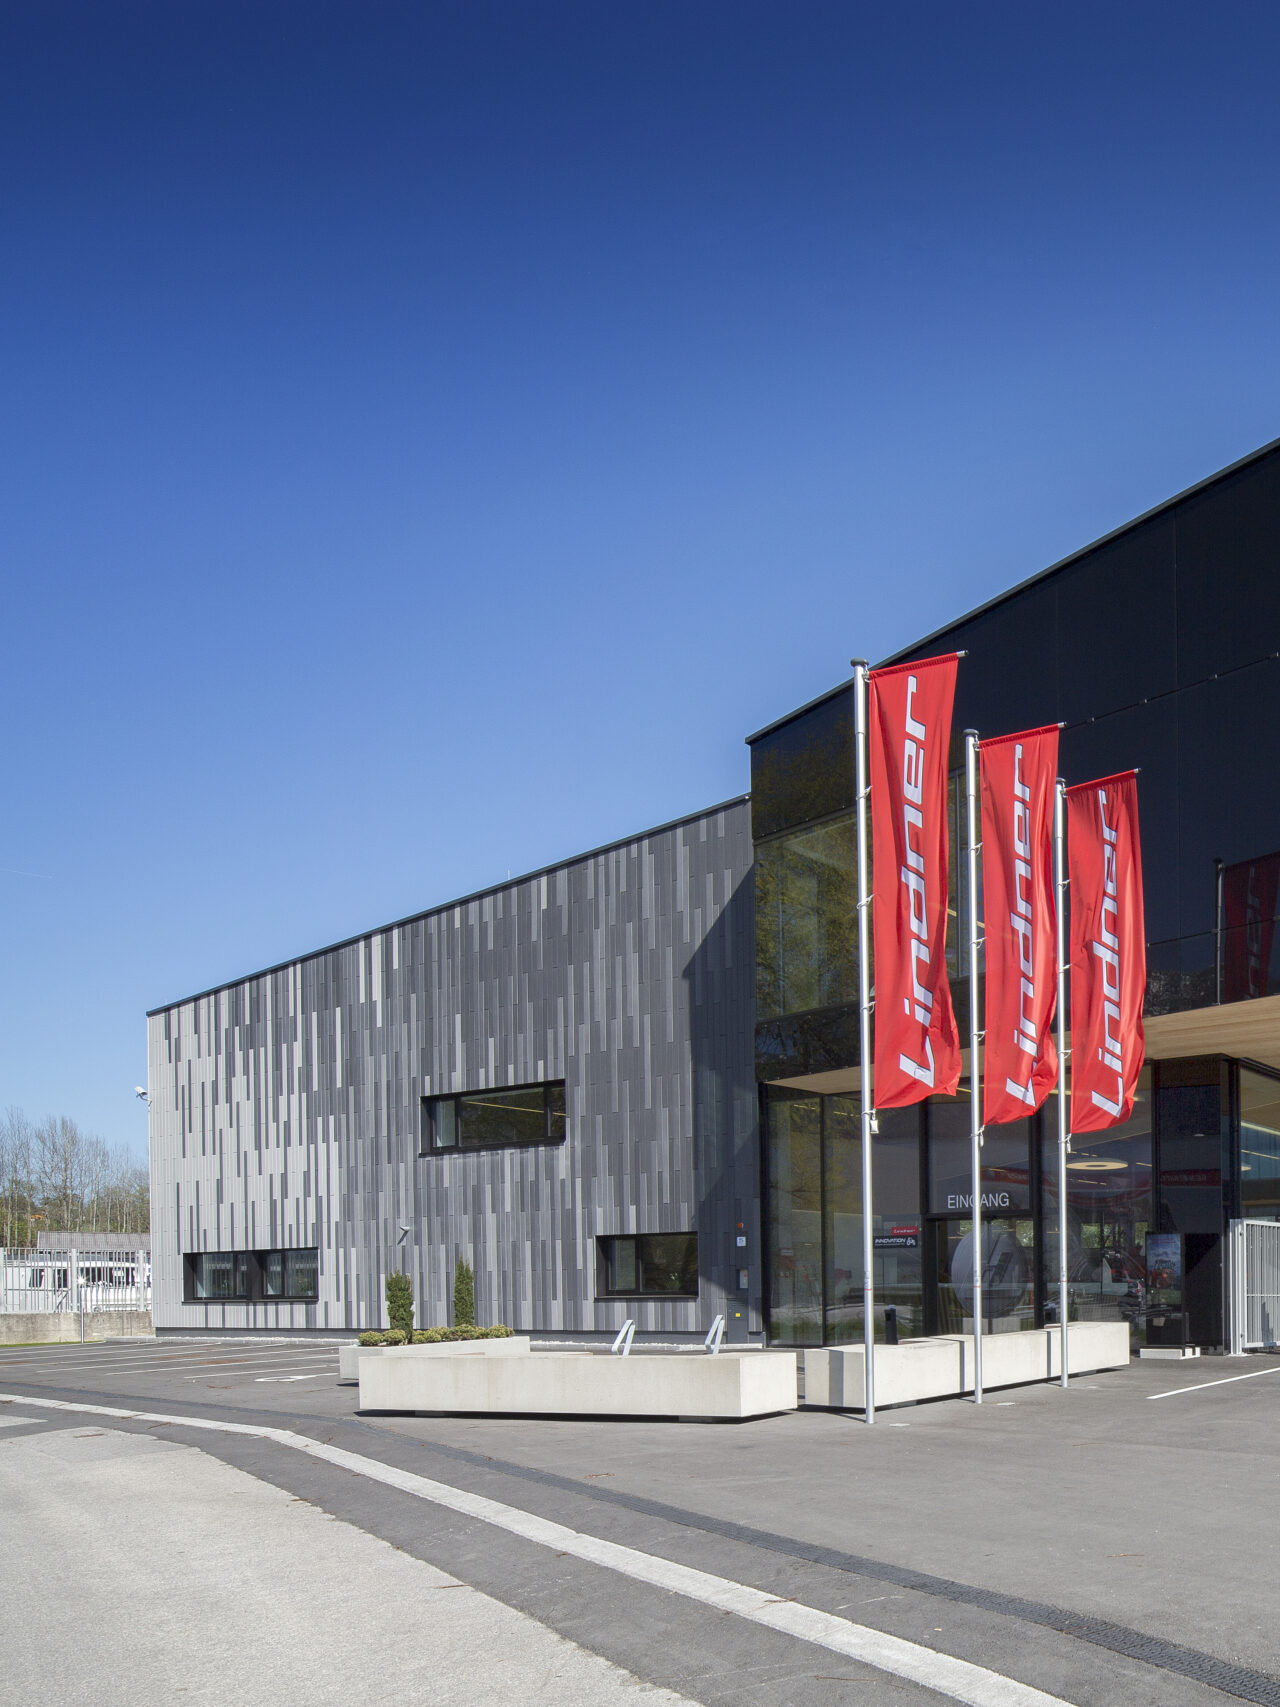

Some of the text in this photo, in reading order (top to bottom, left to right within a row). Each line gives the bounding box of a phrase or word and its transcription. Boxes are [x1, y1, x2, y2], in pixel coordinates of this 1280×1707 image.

[900, 675, 935, 1088] Lindner
[1005, 744, 1038, 1107] Lindner
[1091, 789, 1124, 1118] Lindner
